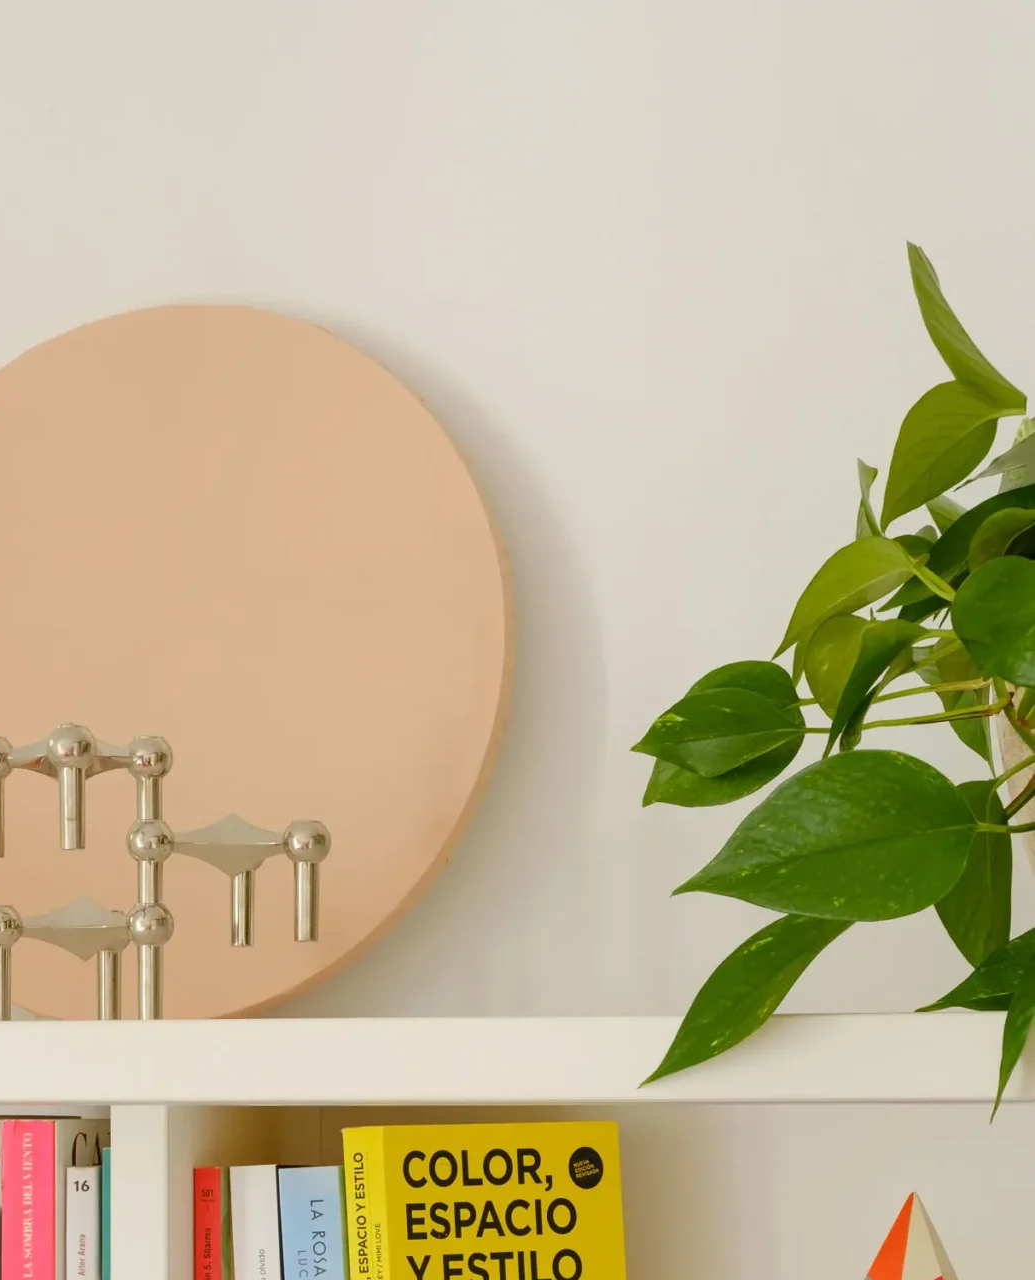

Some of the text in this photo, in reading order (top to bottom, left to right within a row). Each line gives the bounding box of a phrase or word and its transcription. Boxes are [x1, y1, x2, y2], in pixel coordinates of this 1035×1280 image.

[353, 1152, 365, 1199] ESTILO
[402, 1148, 553, 1191] COLOR,
[573, 1159, 590, 1168] NUEVA
[73, 1180, 90, 1192] 16
[202, 1188, 214, 1198] 501
[22, 1132, 34, 1278] LA SOMBRA DEL VIENTO
[310, 1199, 324, 1220] LA
[355, 1203, 366, 1214] Y
[405, 1198, 578, 1241] ESPACIO
[77, 1233, 86, 1277] Aitor Arana
[203, 1227, 211, 1259] Sharma
[311, 1230, 327, 1277] ROSA
[357, 1214, 369, 1274] ESPACIO
[204, 1261, 211, 1270] S.
[257, 1248, 266, 1276] olvido
